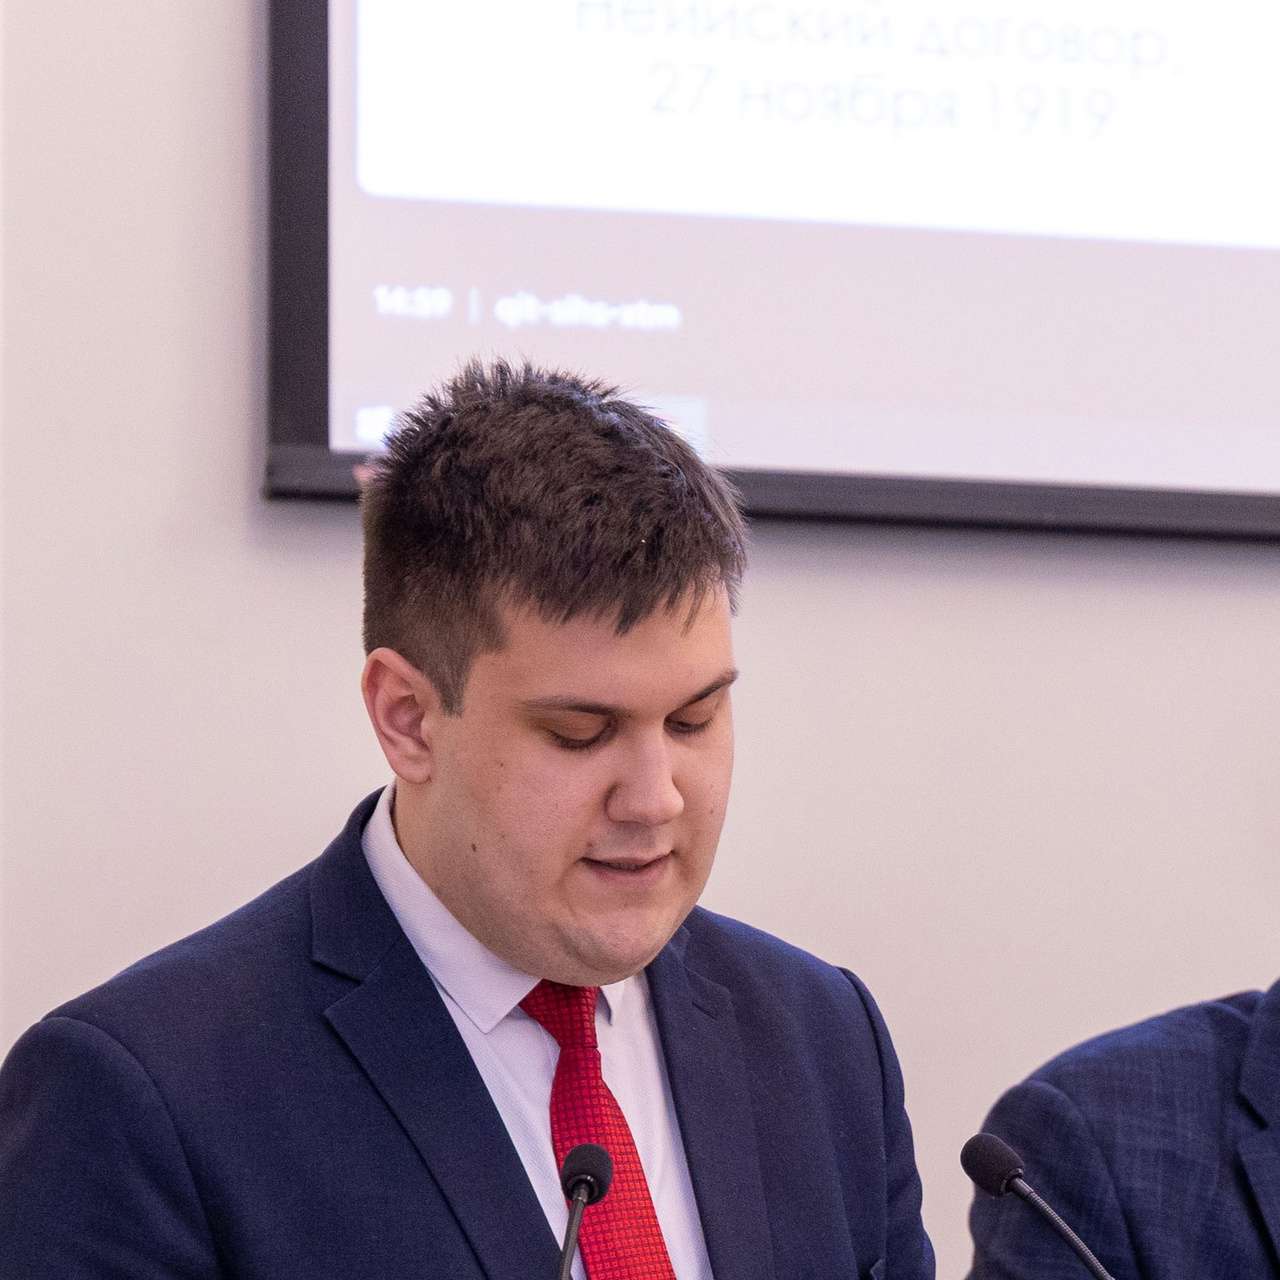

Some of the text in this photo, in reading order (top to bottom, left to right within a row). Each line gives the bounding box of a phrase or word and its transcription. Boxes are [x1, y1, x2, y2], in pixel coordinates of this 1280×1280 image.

[913, 16, 1186, 80] договор,
[646, 58, 1119, 140] 27 ноября 1919
